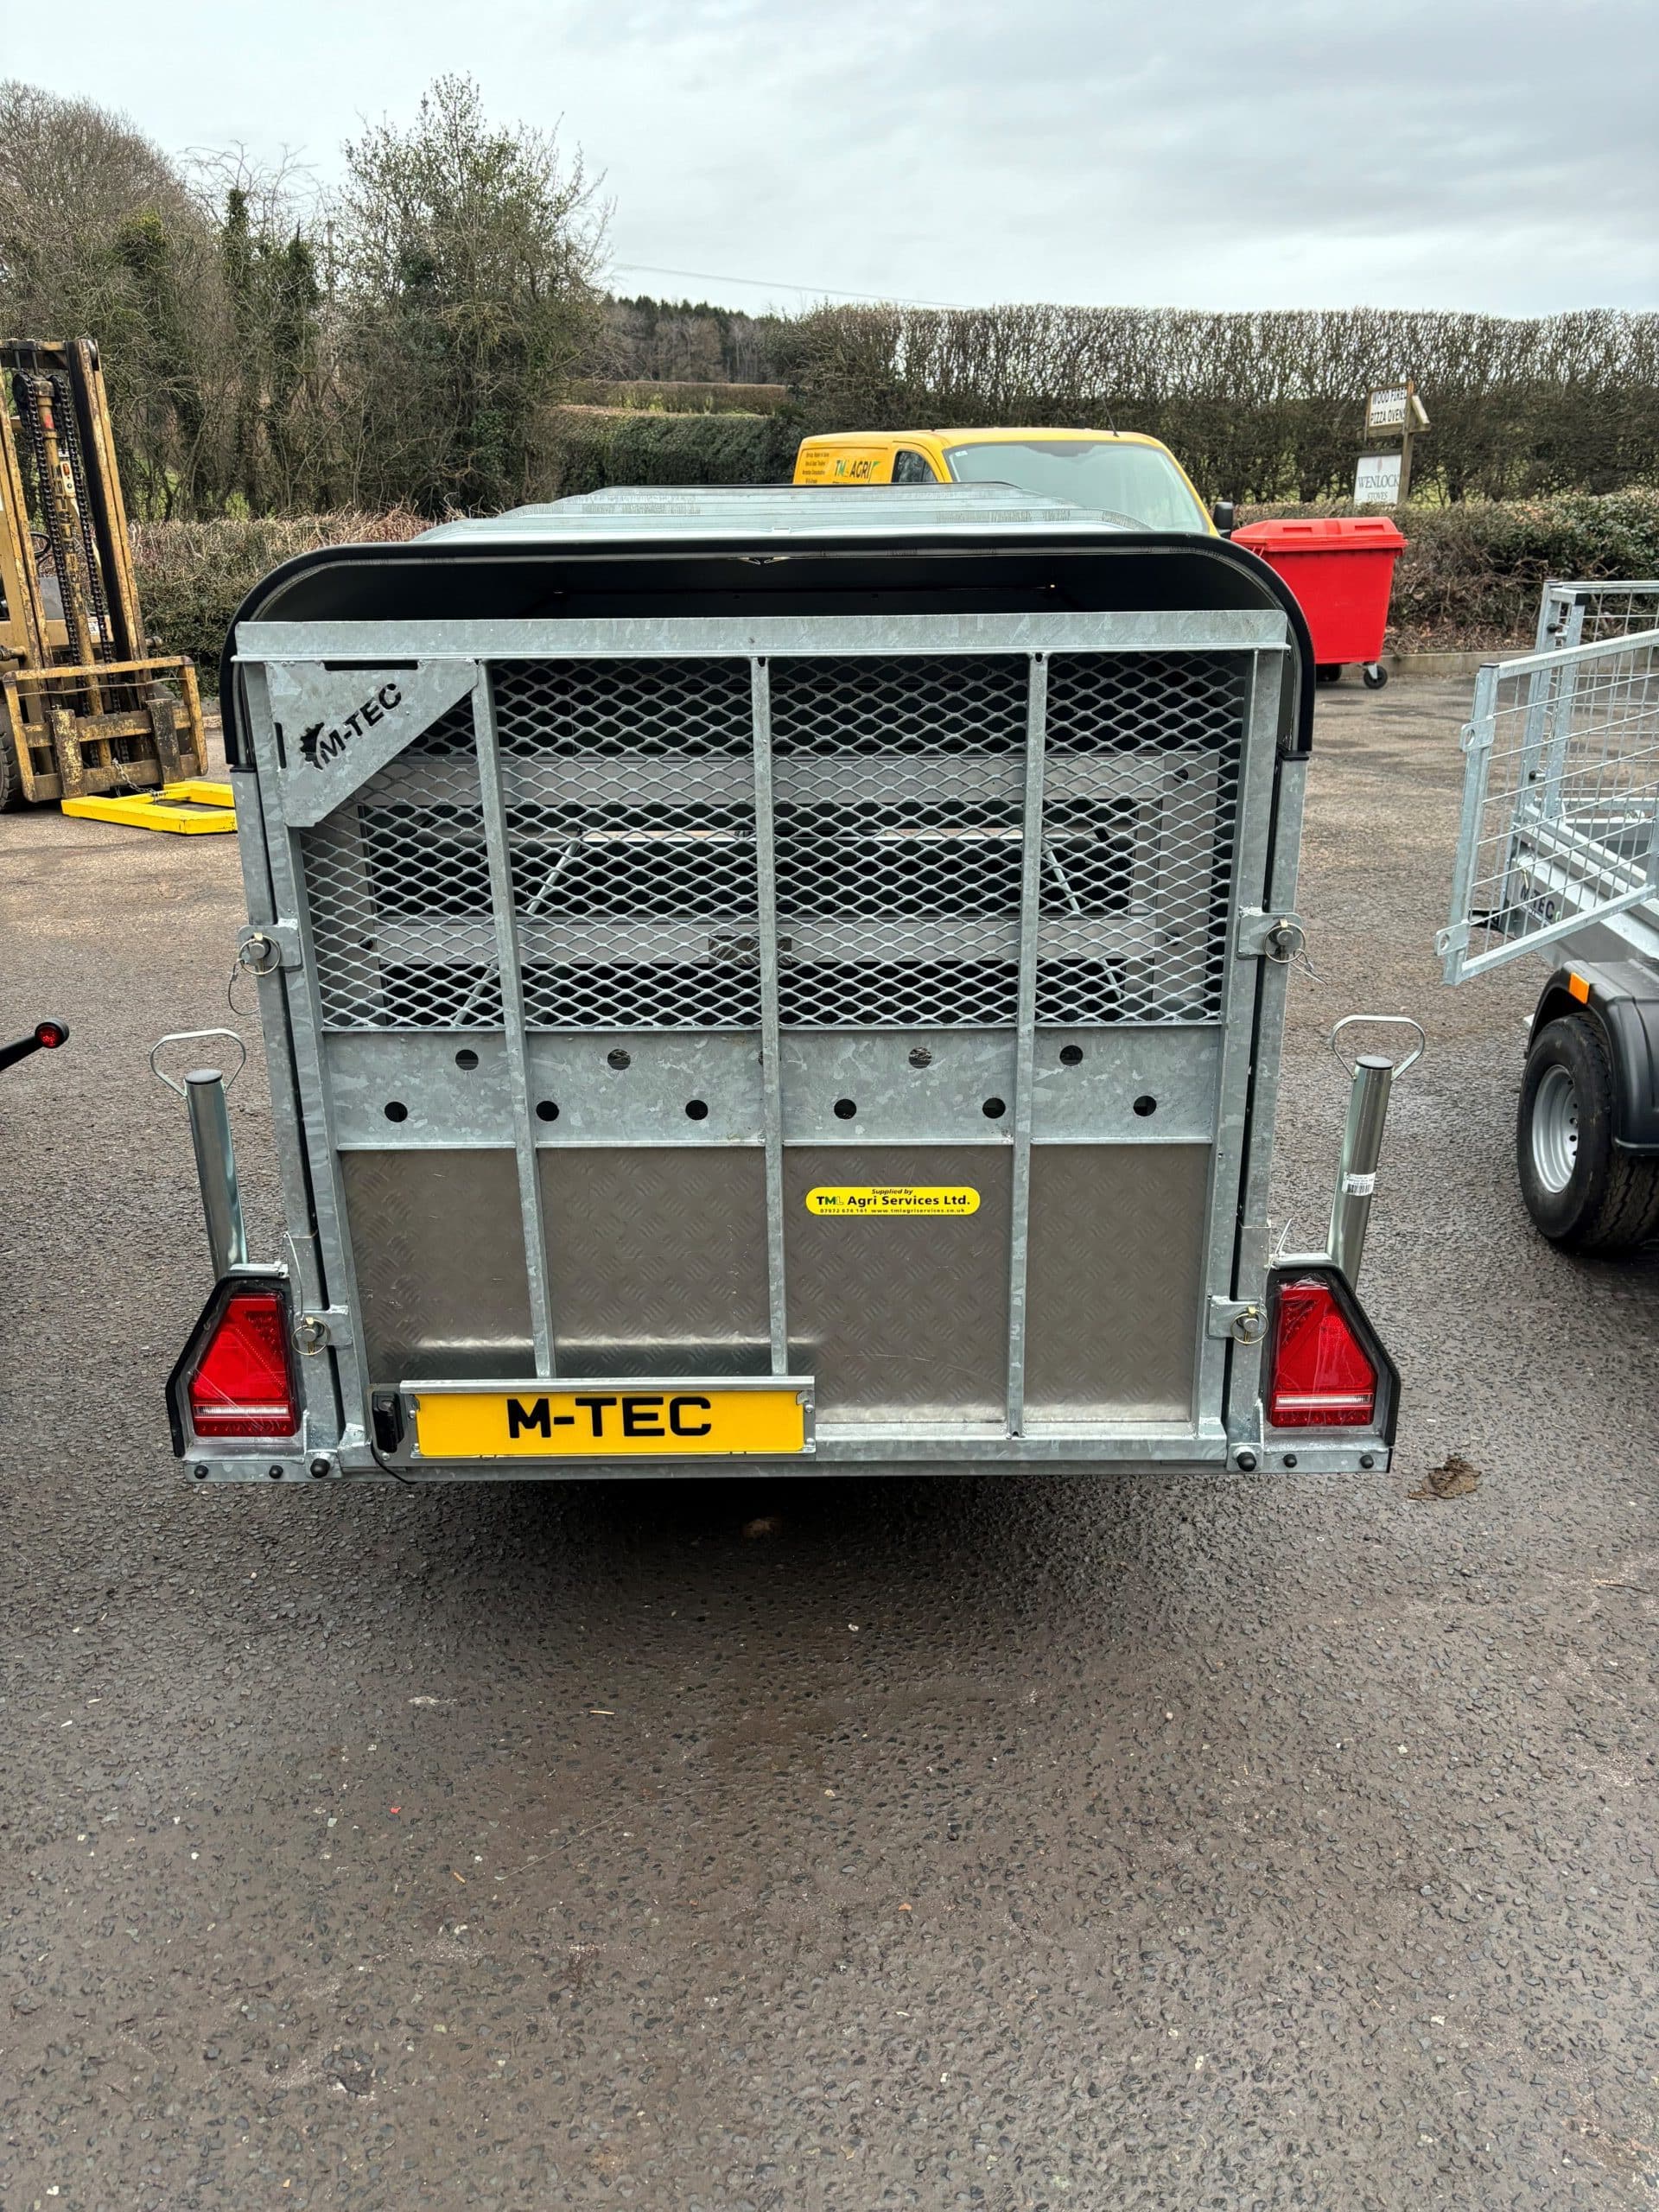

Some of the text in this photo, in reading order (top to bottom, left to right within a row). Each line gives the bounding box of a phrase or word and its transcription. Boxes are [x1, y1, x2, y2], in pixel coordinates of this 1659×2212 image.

[1373, 389, 1389, 404] WOOD
[1370, 410, 1386, 423] PIZZA
[849, 461, 872, 479] AGRI
[1357, 474, 1400, 488] WENLOCK
[320, 683, 402, 764] M-TEC
[816, 1195, 970, 1207] TML Agri Services Ltd.
[506, 1396, 712, 1439] M-TEC
